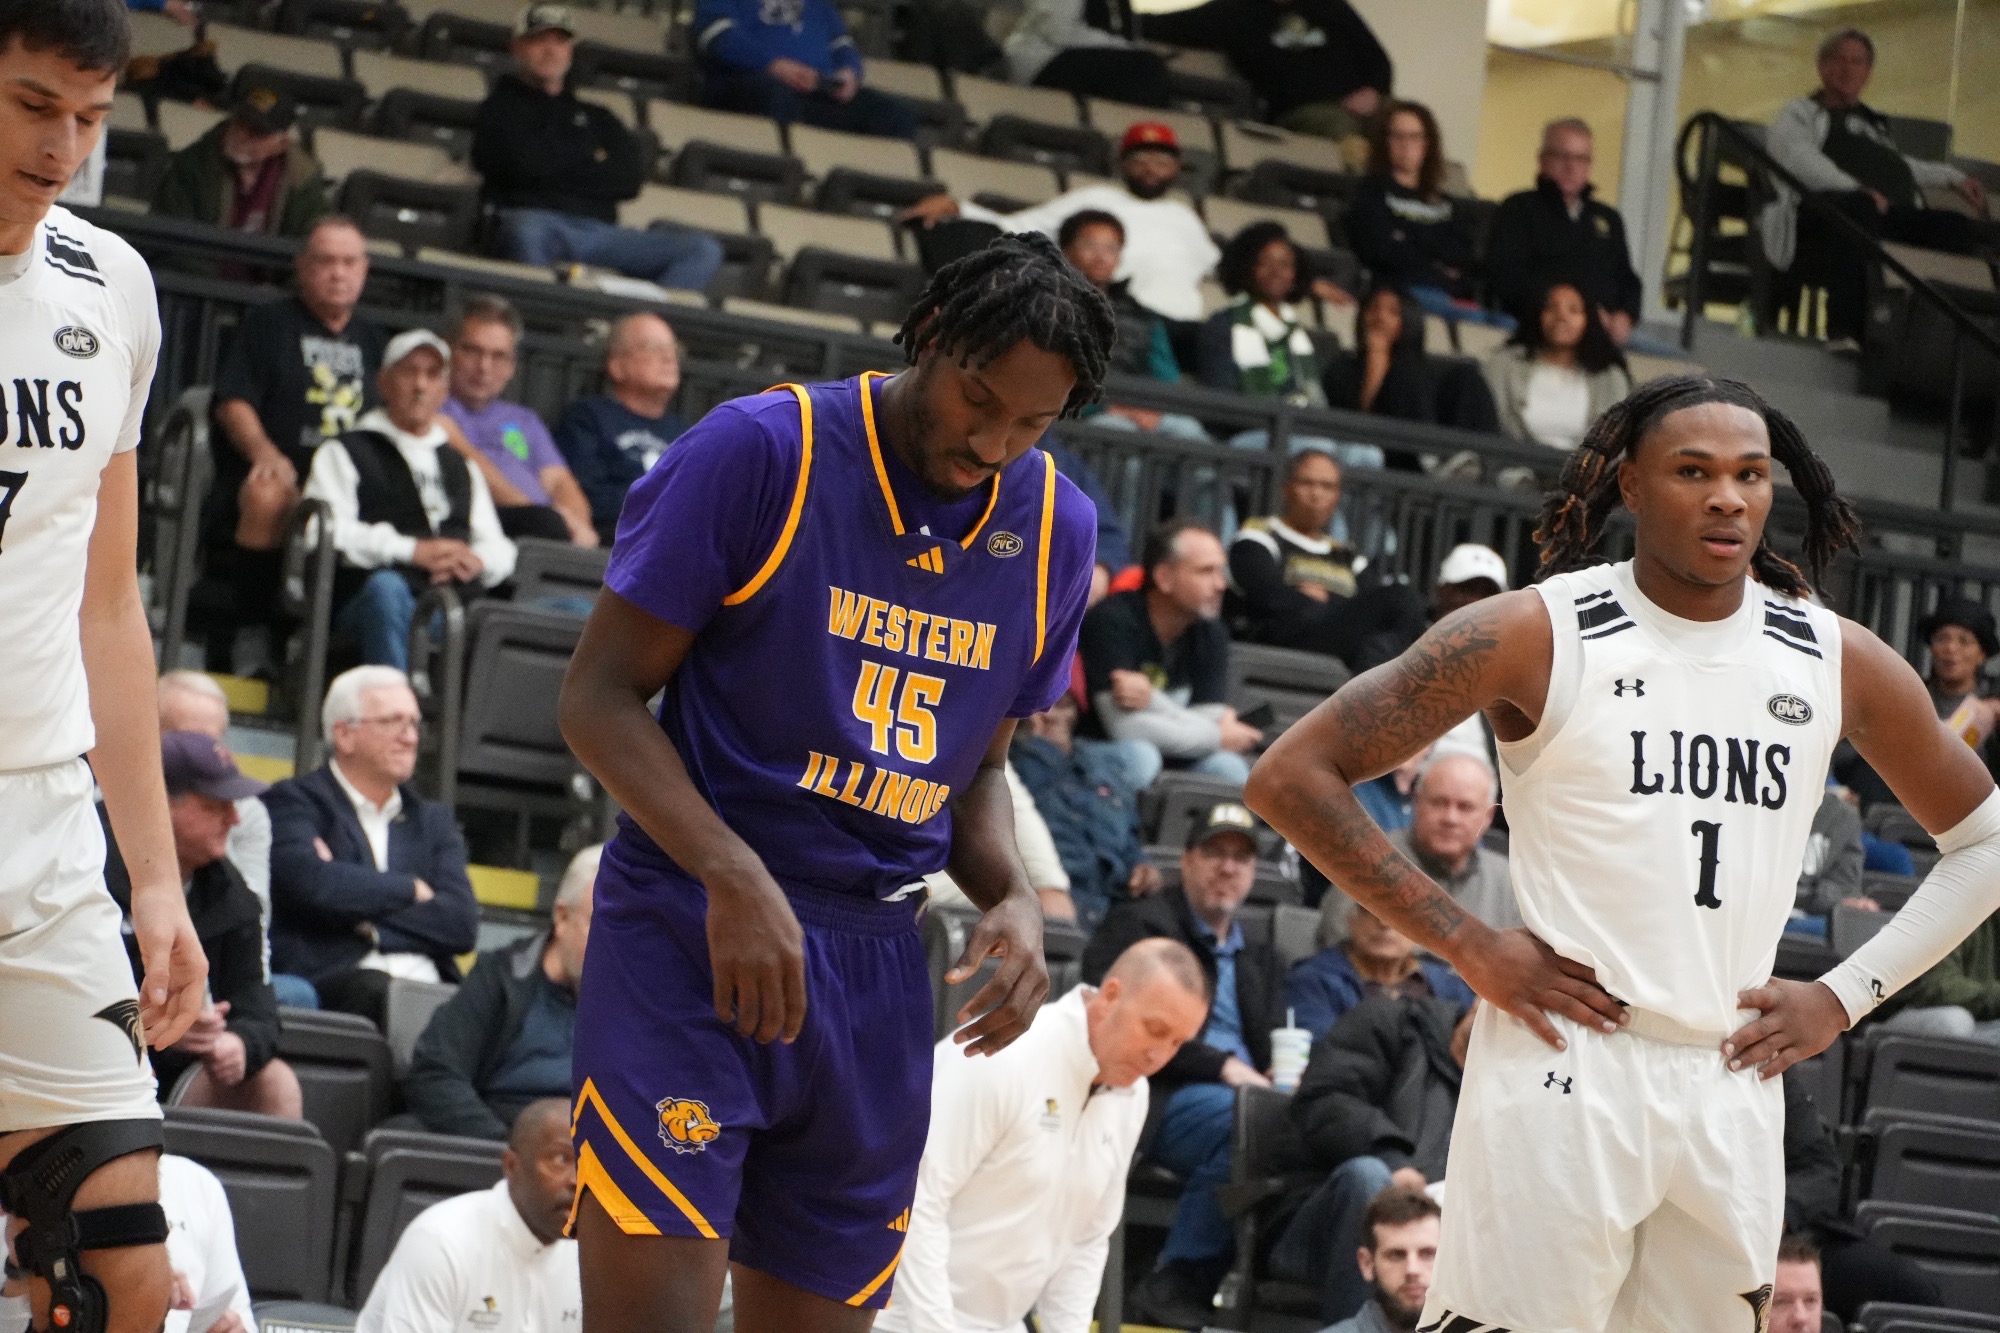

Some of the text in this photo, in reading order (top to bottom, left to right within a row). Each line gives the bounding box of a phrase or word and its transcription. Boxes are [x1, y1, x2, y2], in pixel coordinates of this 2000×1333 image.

[62, 334, 91, 351] OVC
[0, 378, 86, 450] NS
[828, 585, 997, 670] WESTERN
[852, 659, 946, 764] 45
[1775, 701, 1805, 719] OVC
[796, 750, 950, 825] ILLINOIS
[1629, 730, 1791, 810] LIONS
[1691, 820, 1723, 909] 1
